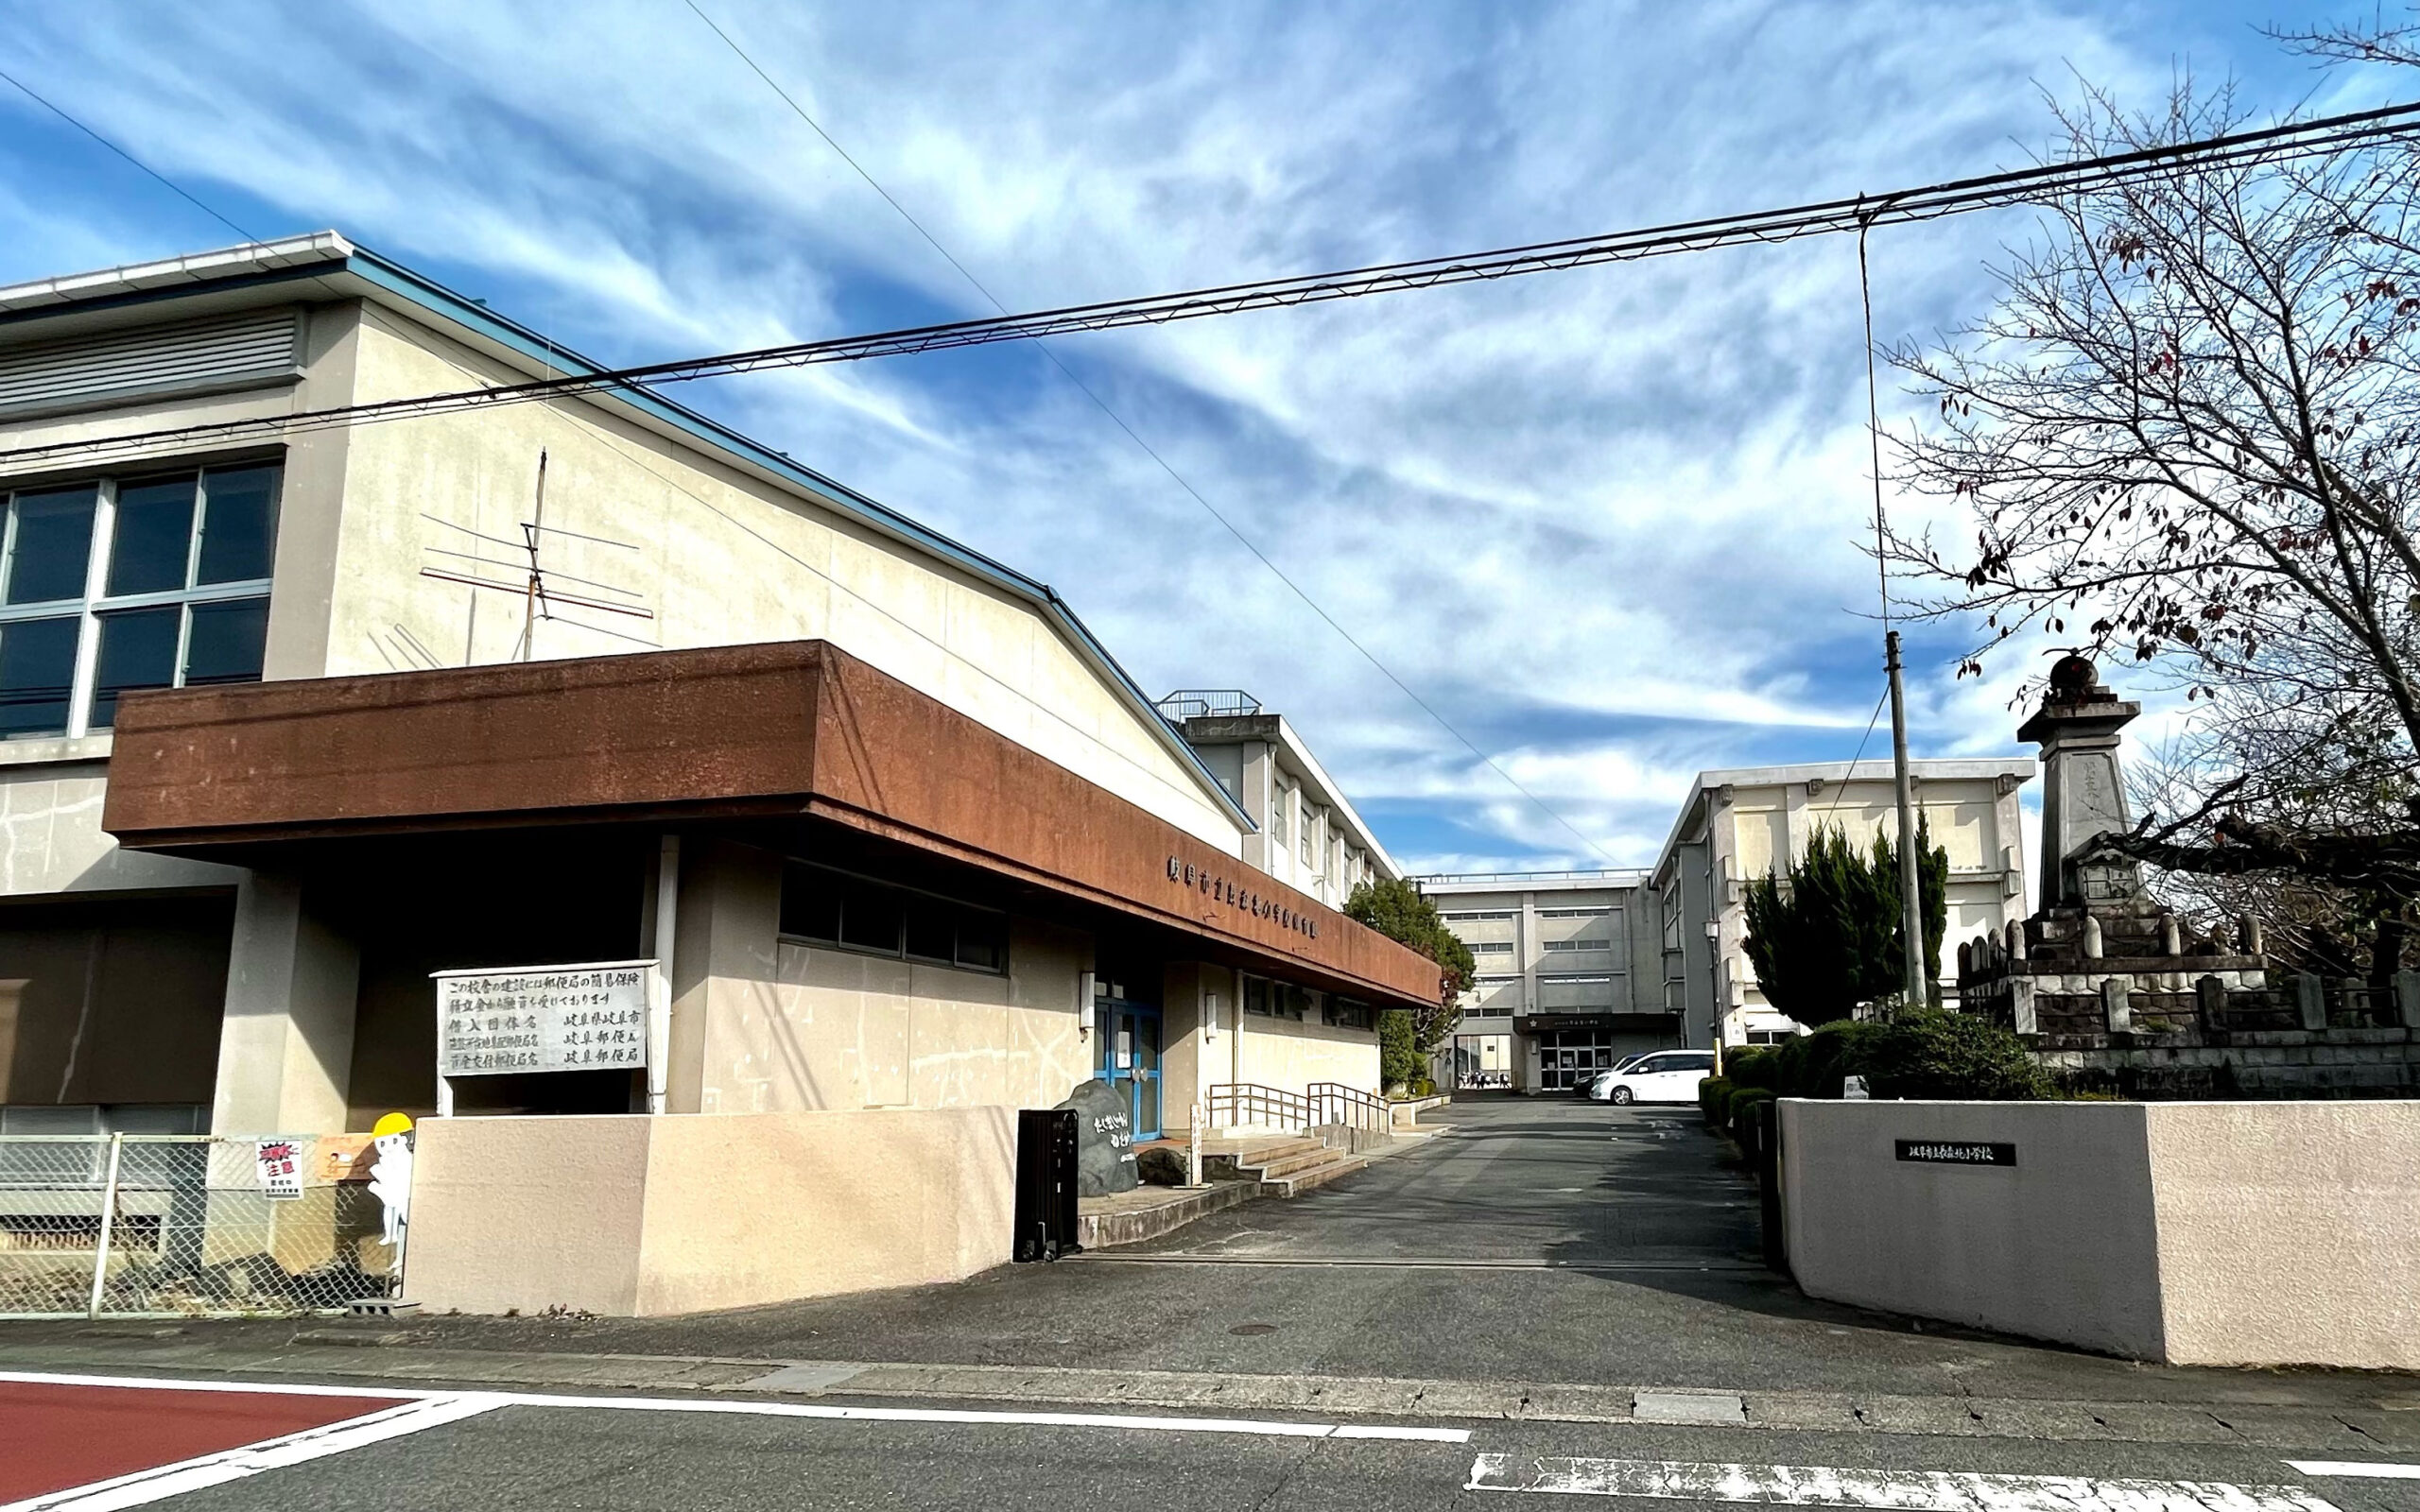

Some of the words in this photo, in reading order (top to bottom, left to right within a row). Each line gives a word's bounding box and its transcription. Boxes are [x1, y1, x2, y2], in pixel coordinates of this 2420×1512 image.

[563, 1010, 641, 1028] 岐阜県岐阜市
[563, 1048, 638, 1064] 岐阜郵便局
